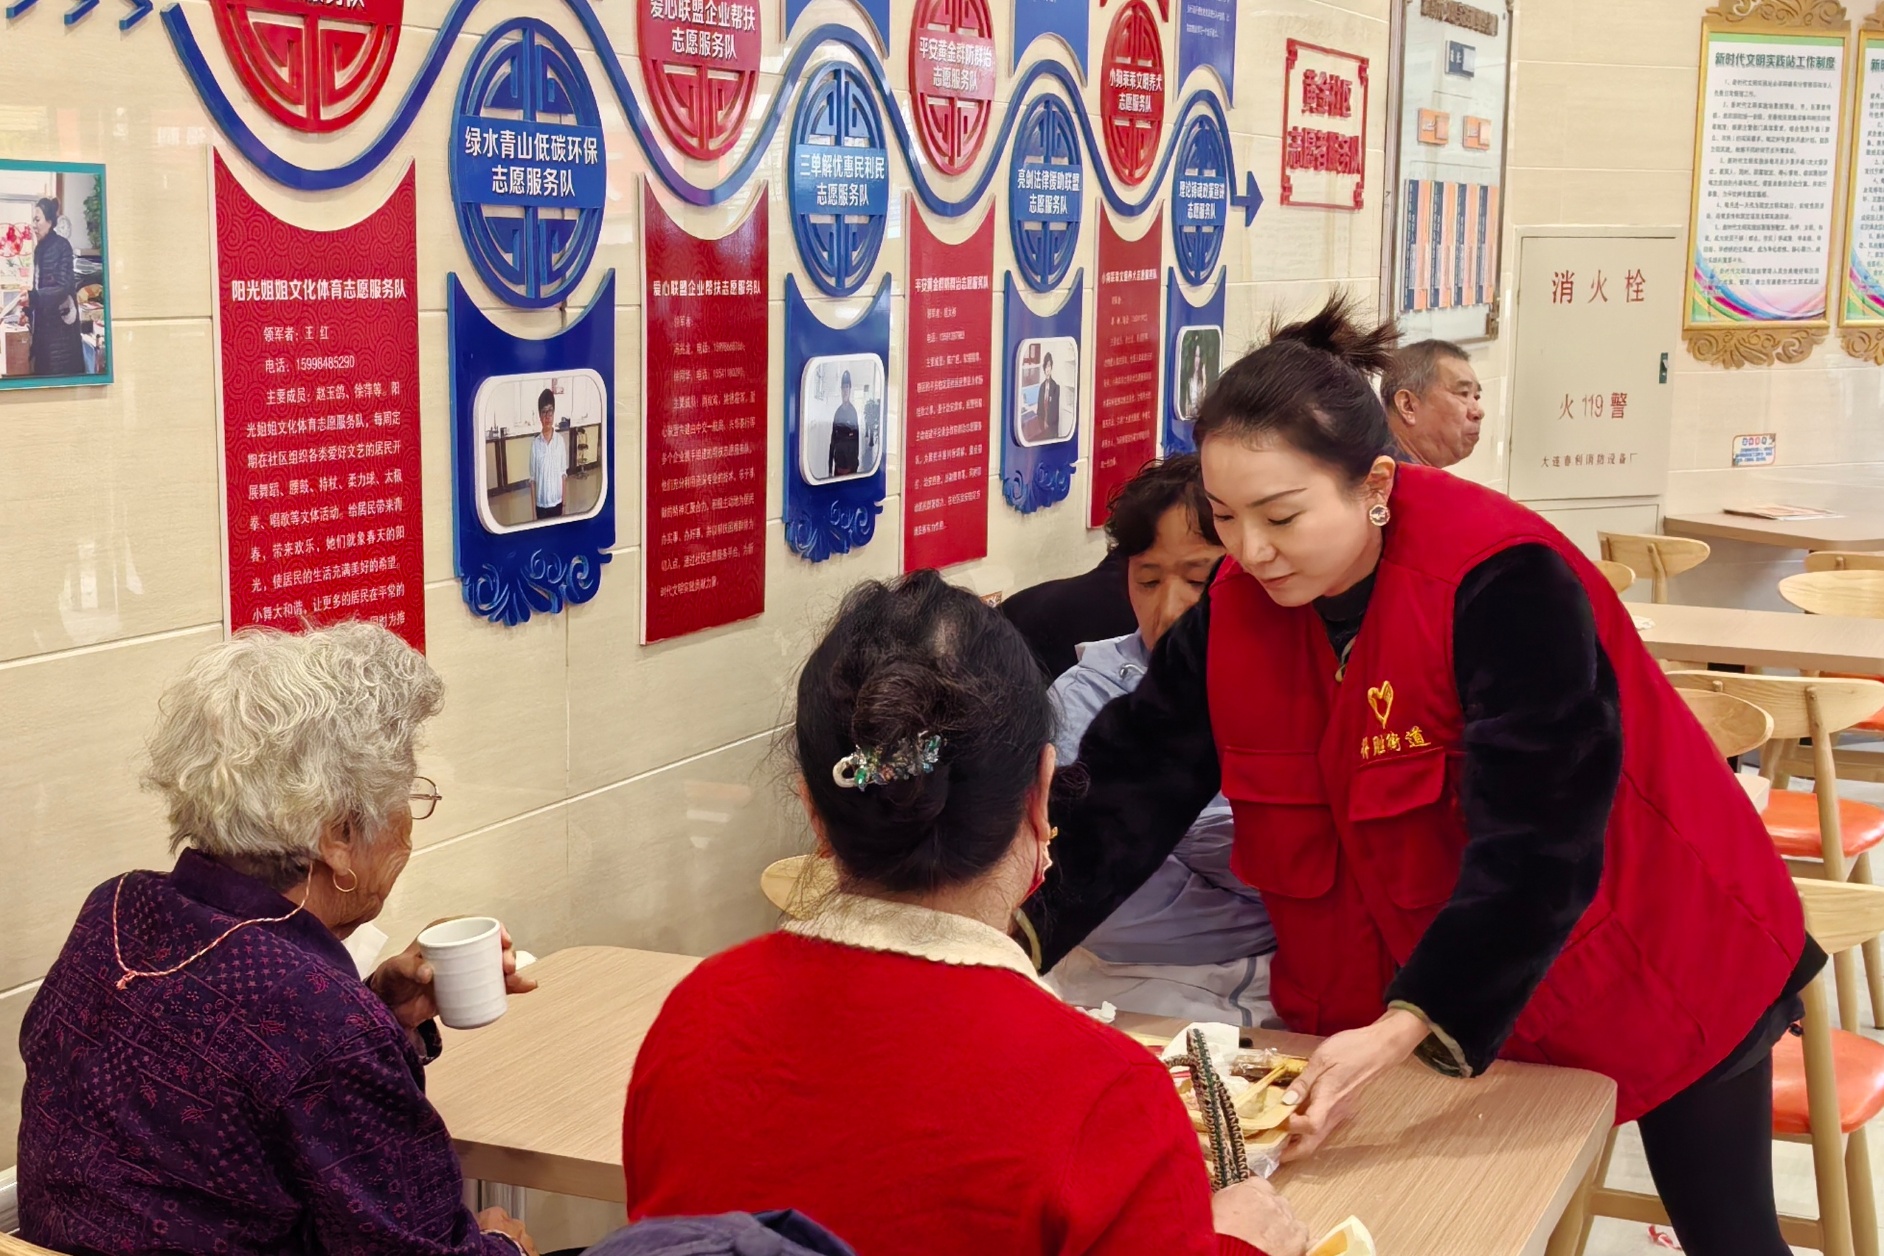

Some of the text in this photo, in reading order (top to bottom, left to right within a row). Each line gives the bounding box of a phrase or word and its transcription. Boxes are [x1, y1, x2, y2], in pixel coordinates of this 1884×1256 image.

[651, 0, 756, 31] 爱心联盟企业帮扶
[671, 26, 738, 60] 志愿服务队
[919, 36, 993, 68] 平安黄金群防群治
[1714, 52, 1836, 71] 新时代文明实践站工作制度
[932, 65, 978, 92] 志愿服务队
[1118, 92, 1153, 113] 志愿服务队
[464, 125, 598, 165] 绿水青山低碳环保
[491, 164, 576, 197] 志愿服务队
[1017, 168, 1080, 192] 亮剑法律援助联盟
[816, 182, 870, 206] 志愿服务队
[1028, 192, 1068, 215] 志愿服务队
[1187, 201, 1217, 220] 志愿服务队
[231, 278, 407, 302] 阳光姐姐文化体育志愿服务队
[653, 279, 762, 297] 爱心联盟企业帮扶志愿服务队
[1551, 268, 1646, 304] 消火栓
[247, 440, 401, 469] 期在社区组织各类爱好文艺的居民开
